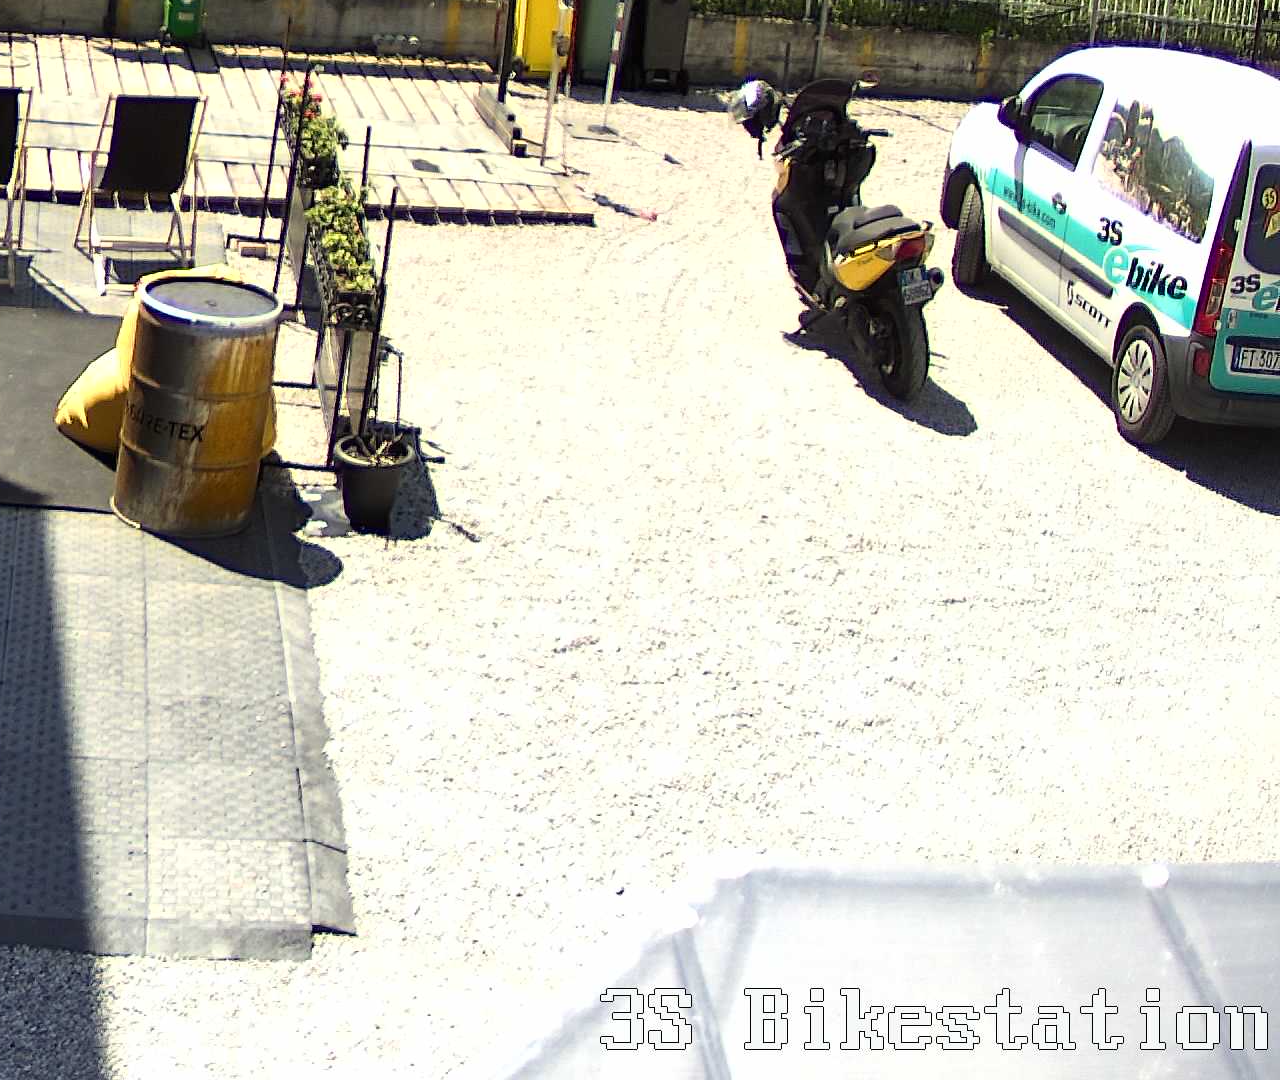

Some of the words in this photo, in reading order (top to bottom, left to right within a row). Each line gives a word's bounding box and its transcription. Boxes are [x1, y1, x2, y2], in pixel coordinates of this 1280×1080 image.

[1096, 217, 1124, 246] 3S
[1230, 274, 1261, 294] 3S
[1074, 294, 1113, 329] SCOTT
